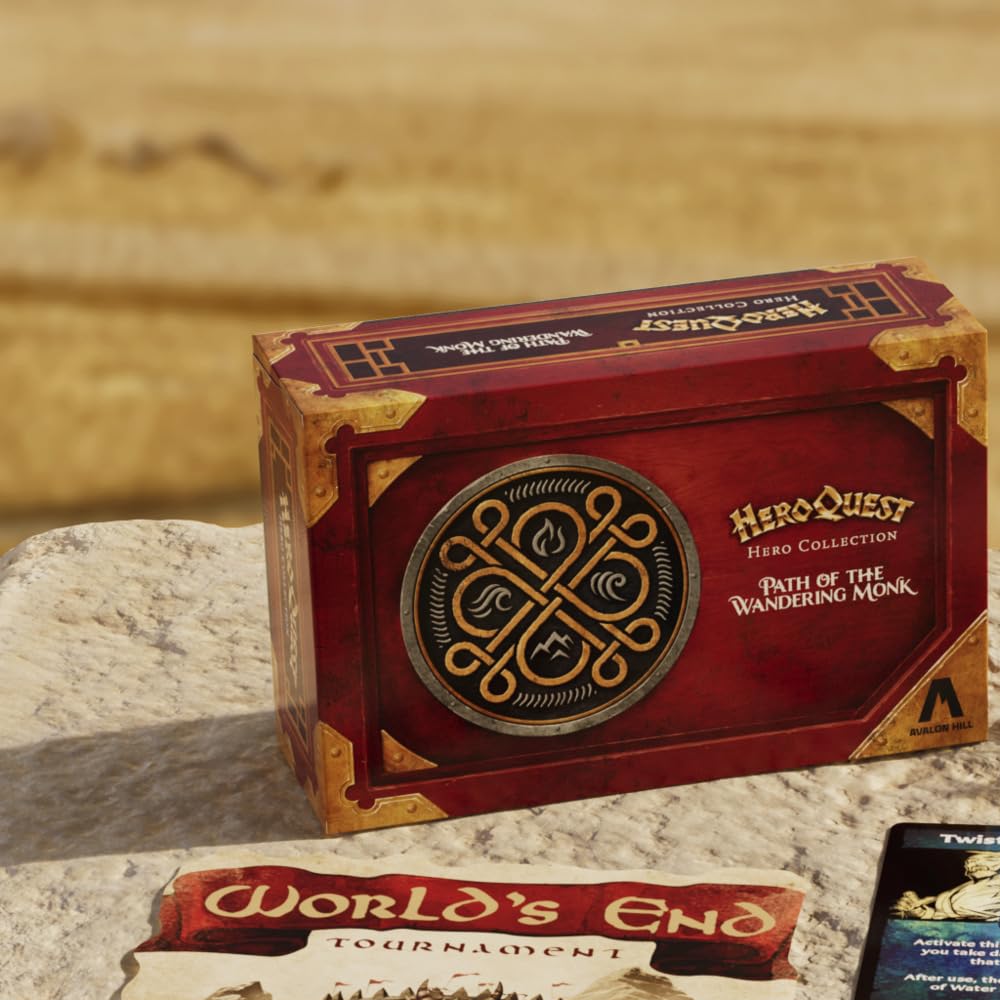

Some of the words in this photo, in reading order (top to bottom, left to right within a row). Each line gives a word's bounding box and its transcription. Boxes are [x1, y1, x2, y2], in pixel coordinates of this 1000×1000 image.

[747, 544, 791, 559] HERO
[798, 531, 898, 552] COLLECTION
[758, 575, 810, 596] PATH
[816, 571, 840, 588] OF
[846, 566, 884, 584] THE
[728, 588, 846, 616] WANDERING
[853, 576, 919, 602] MONK
[909, 723, 949, 736] AVALON
[952, 720, 974, 731] HILL
[913, 939, 976, 948] Activate
[920, 948, 949, 957] you
[953, 948, 986, 957] take
[970, 958, 1000, 966] that
[904, 973, 944, 981] After
[947, 975, 977, 984] use,
[930, 983, 948, 991] of
[950, 984, 997, 993] Water
